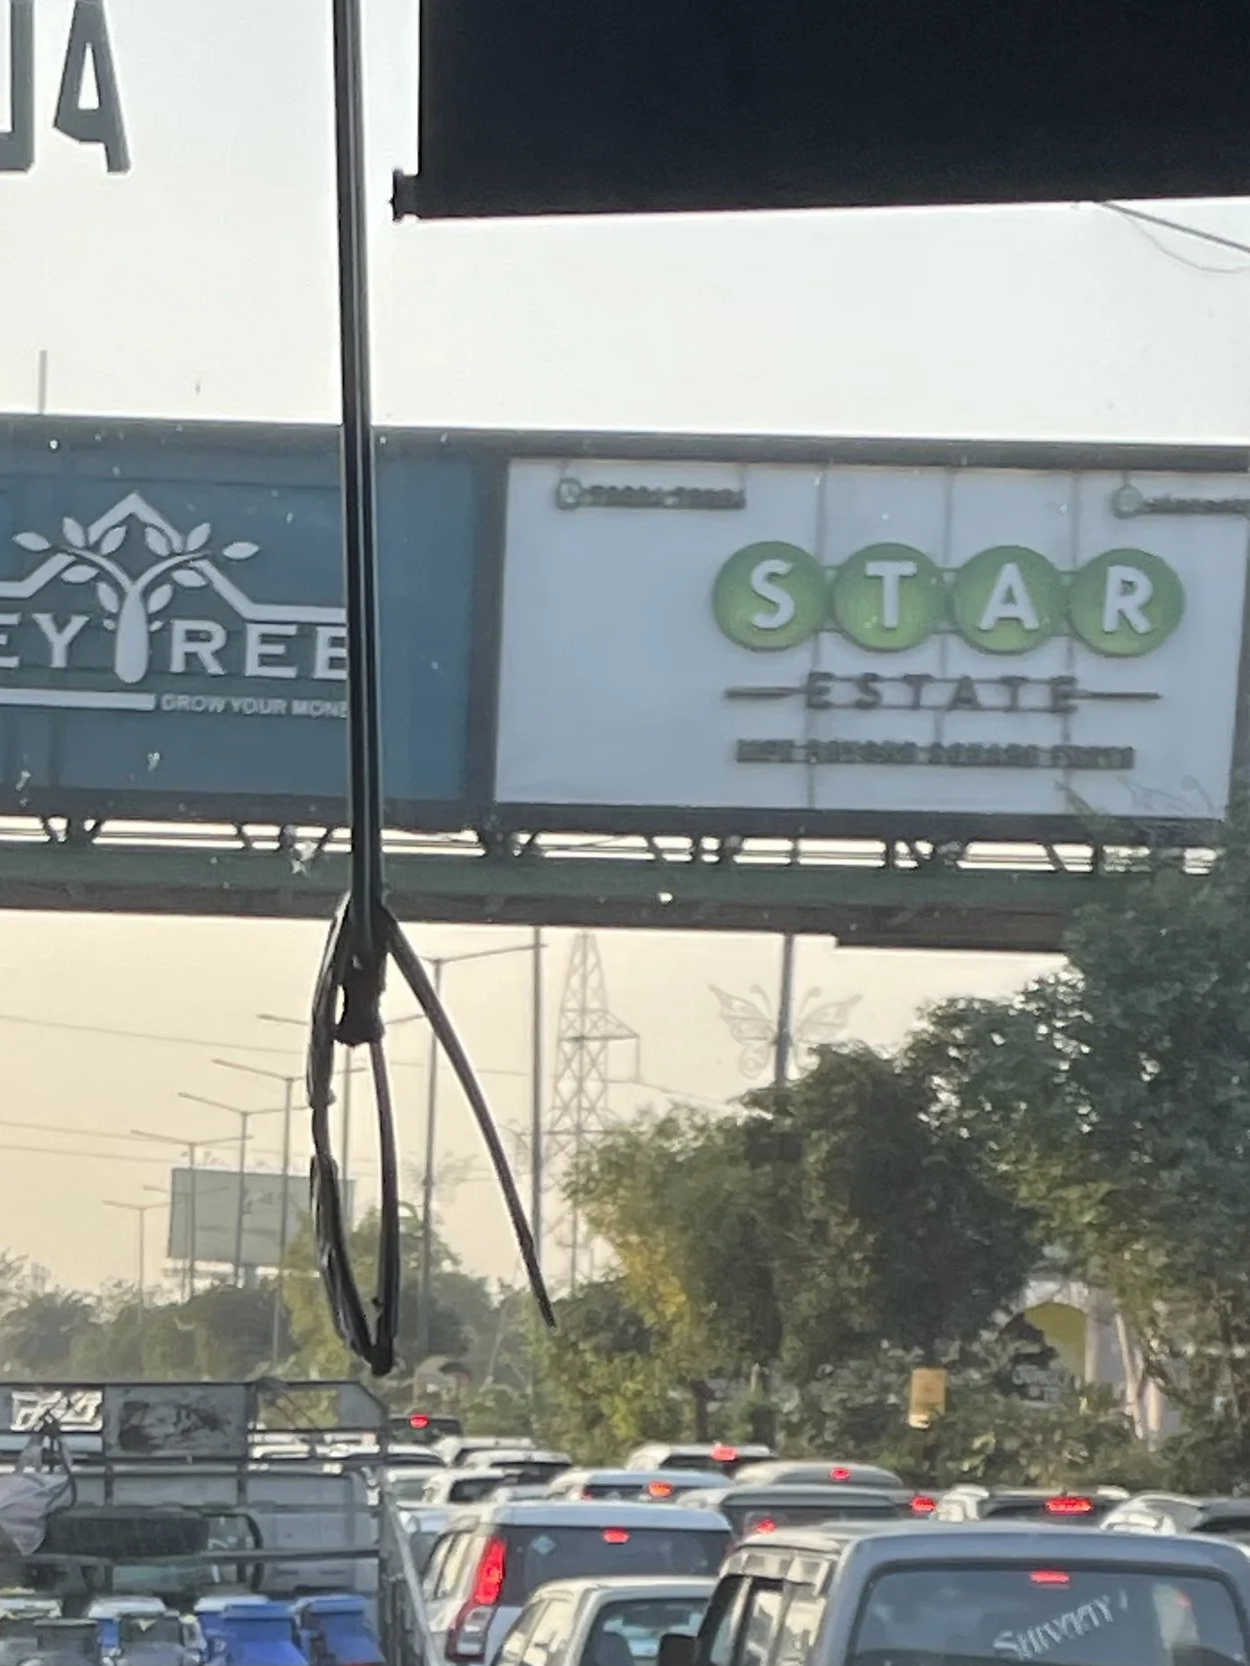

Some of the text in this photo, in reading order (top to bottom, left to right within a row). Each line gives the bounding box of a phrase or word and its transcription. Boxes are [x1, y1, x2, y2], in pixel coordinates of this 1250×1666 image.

[161, 692, 349, 719] GROW YOUR MONE
[806, 671, 1079, 713] ESTATE
